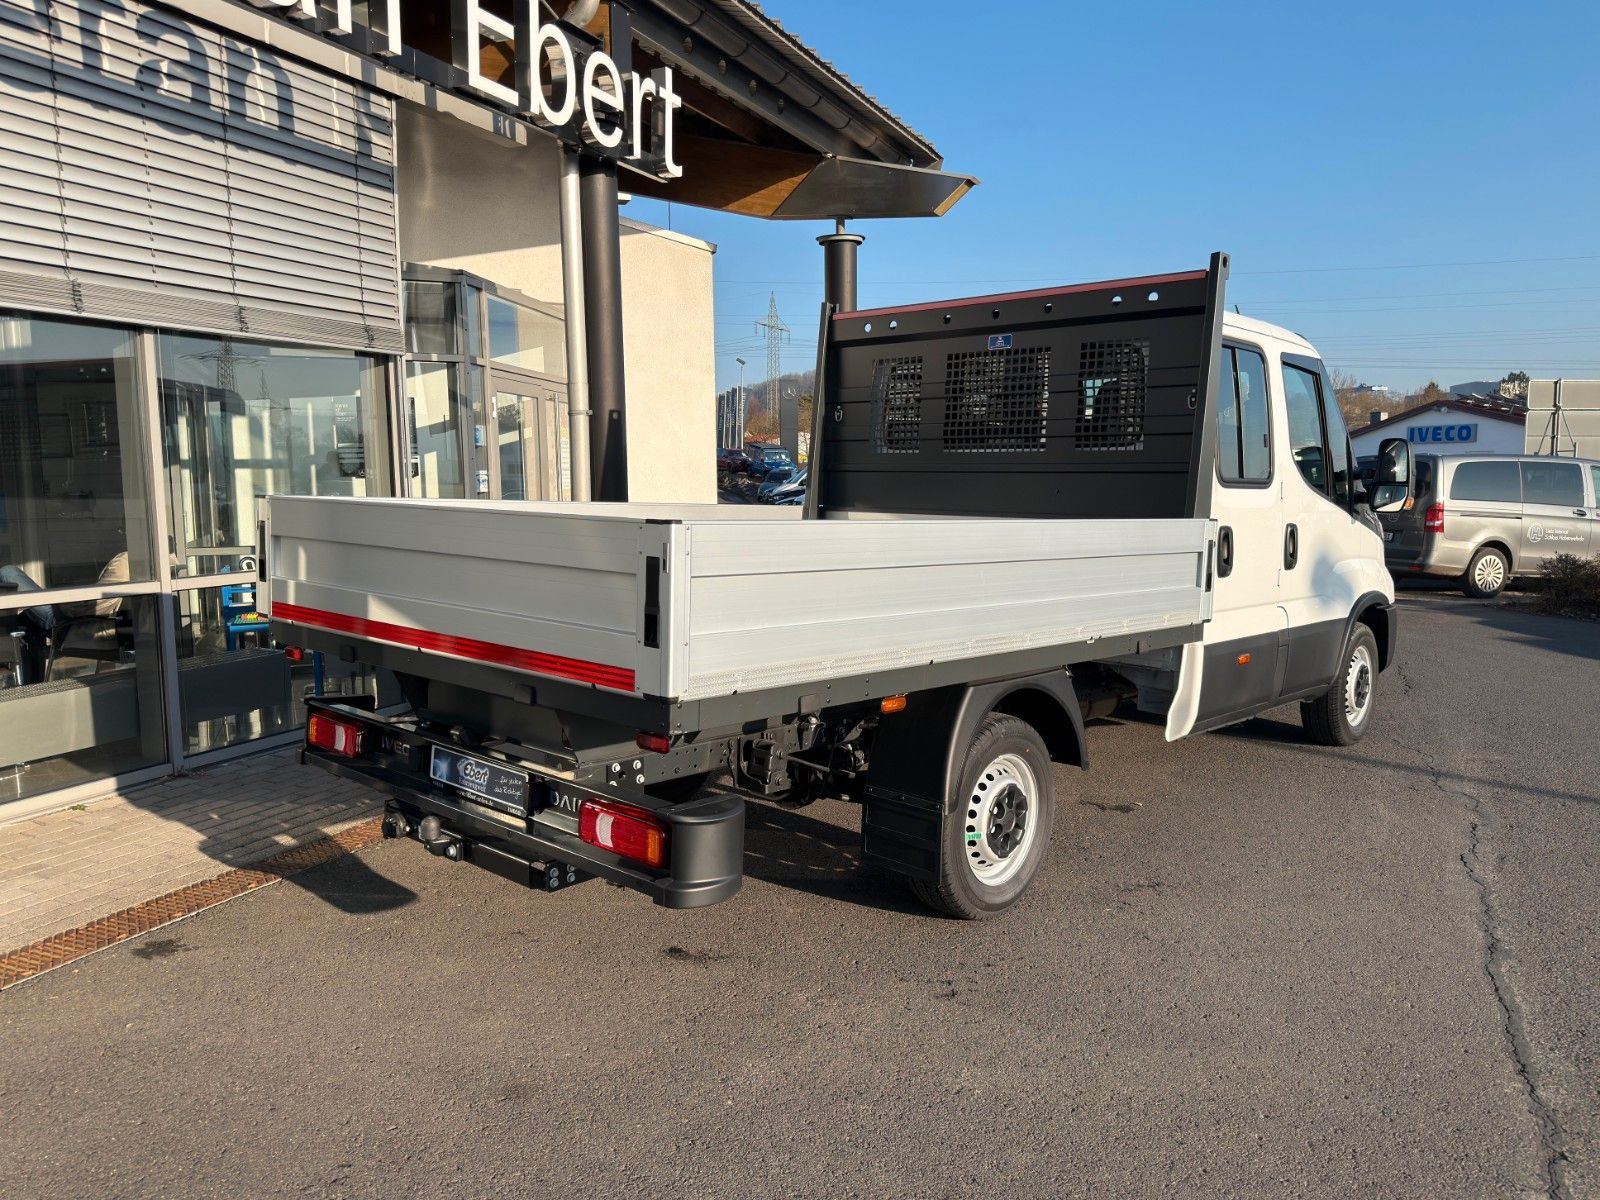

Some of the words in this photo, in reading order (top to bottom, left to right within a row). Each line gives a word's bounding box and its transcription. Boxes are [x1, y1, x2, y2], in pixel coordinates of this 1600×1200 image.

[466, 0, 683, 178] Ebert
[1409, 425, 1472, 443] IVECO
[463, 760, 490, 784] Ebert
